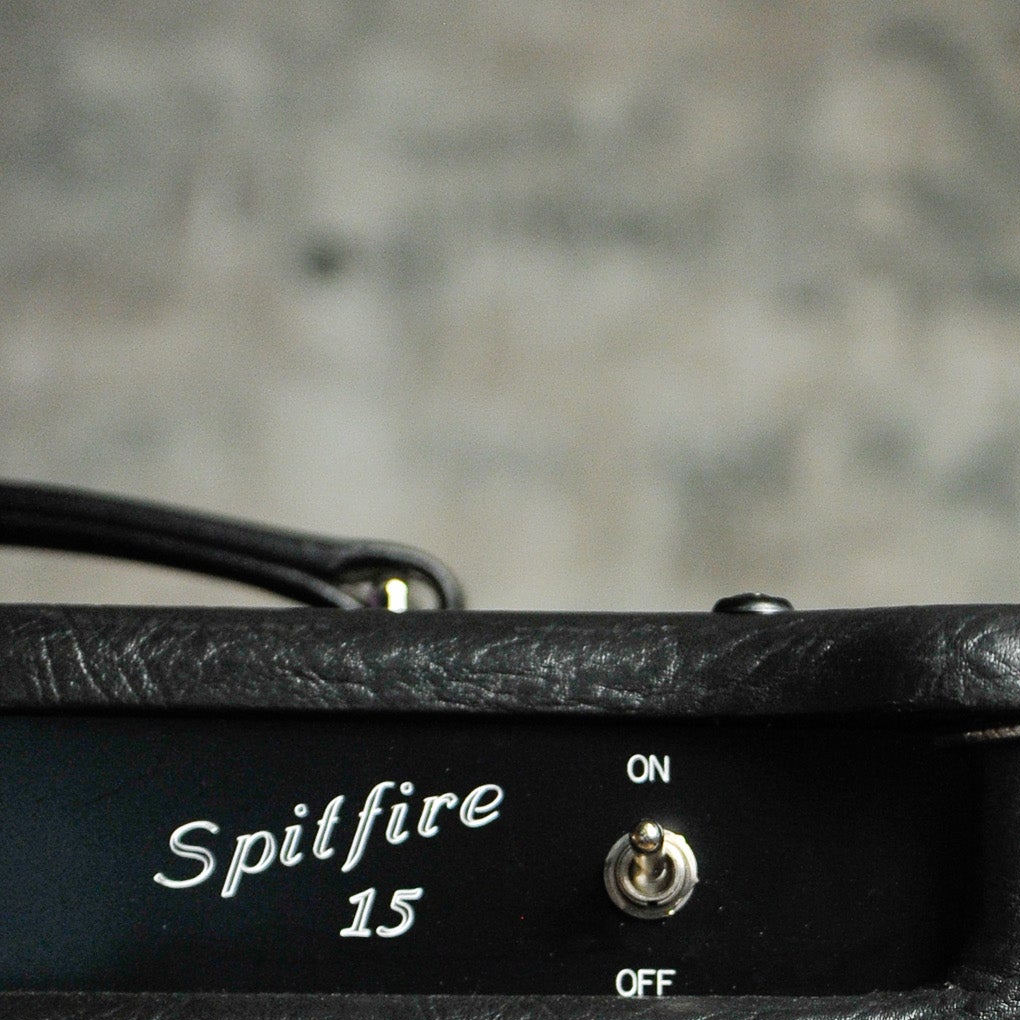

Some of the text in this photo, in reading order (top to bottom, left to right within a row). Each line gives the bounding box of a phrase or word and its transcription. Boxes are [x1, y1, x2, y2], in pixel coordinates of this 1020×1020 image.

[626, 753, 671, 784] ON
[152, 780, 505, 899] Spitfire
[339, 887, 424, 938] 15
[614, 967, 677, 998] OFF
